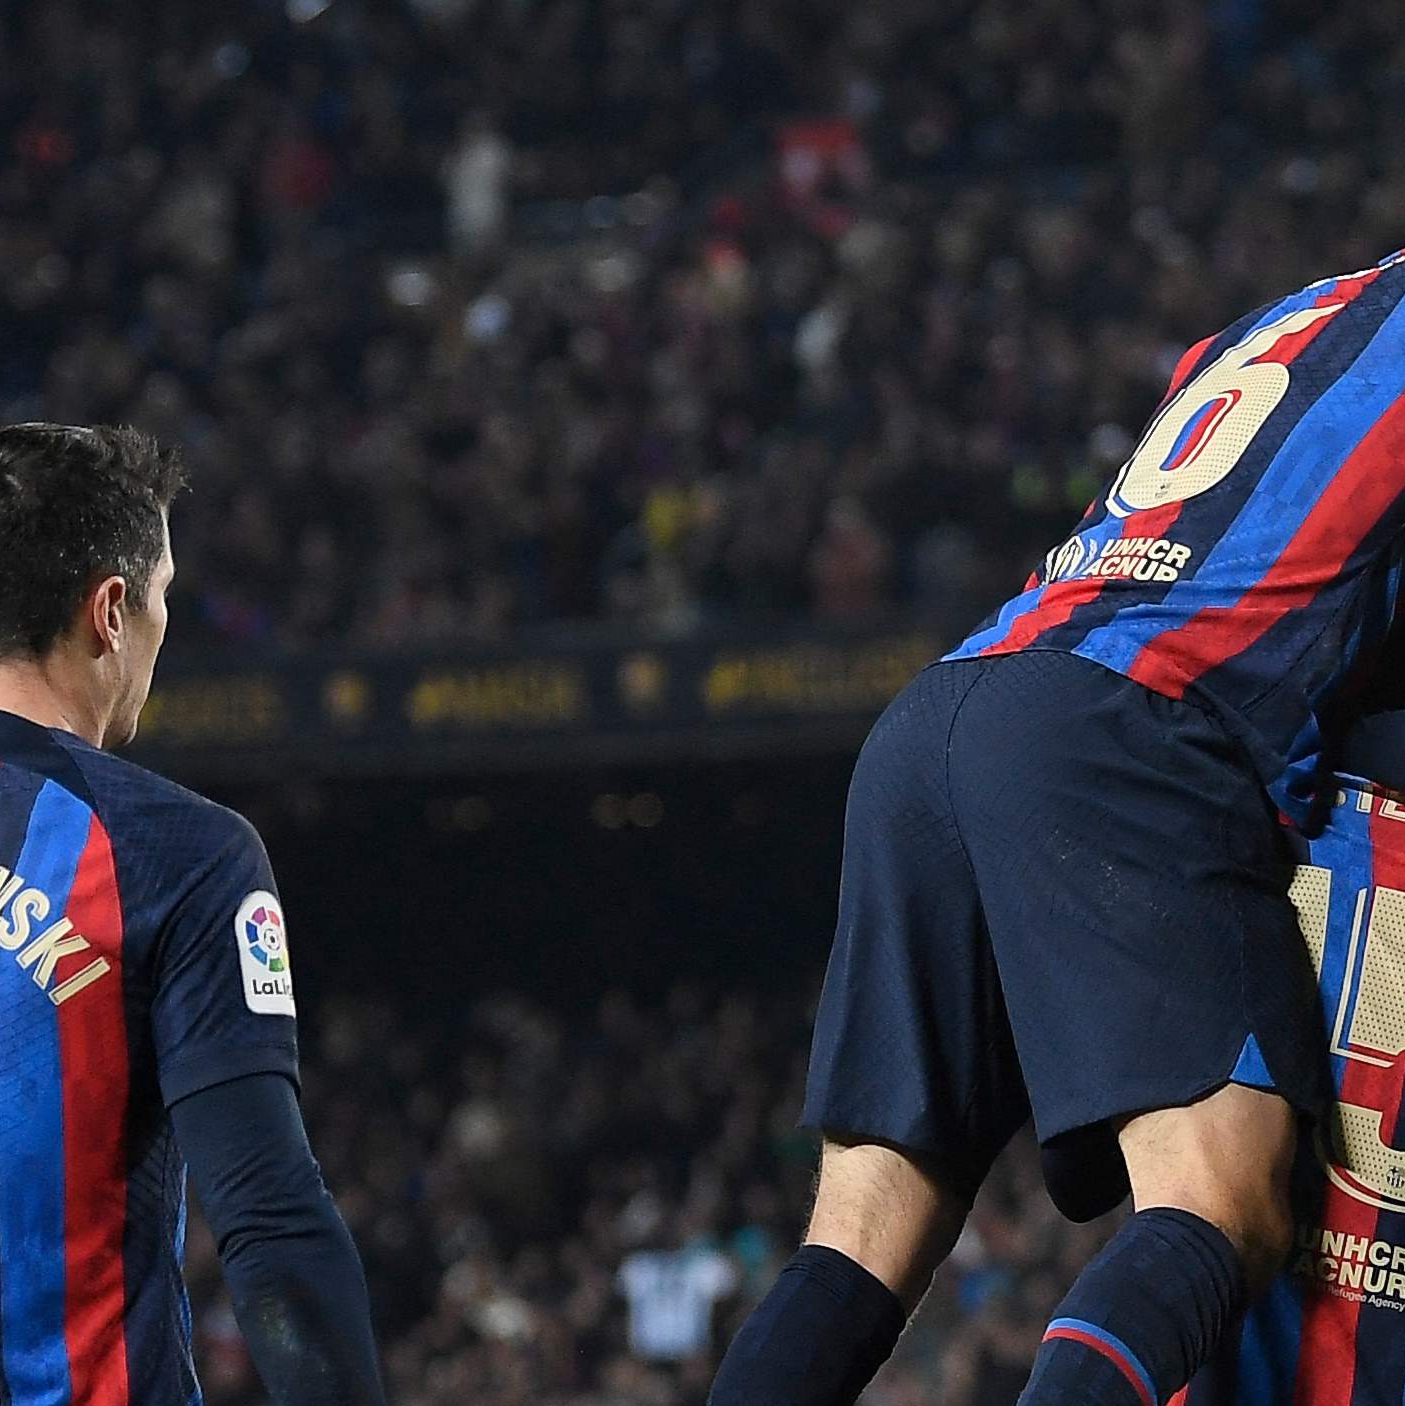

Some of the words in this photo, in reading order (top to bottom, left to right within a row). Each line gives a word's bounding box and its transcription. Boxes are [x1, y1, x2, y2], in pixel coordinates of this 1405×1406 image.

[1106, 302, 1345, 517] 6
[1100, 537, 1192, 568] UNHCR
[1367, 1294, 1405, 1313] Agency
